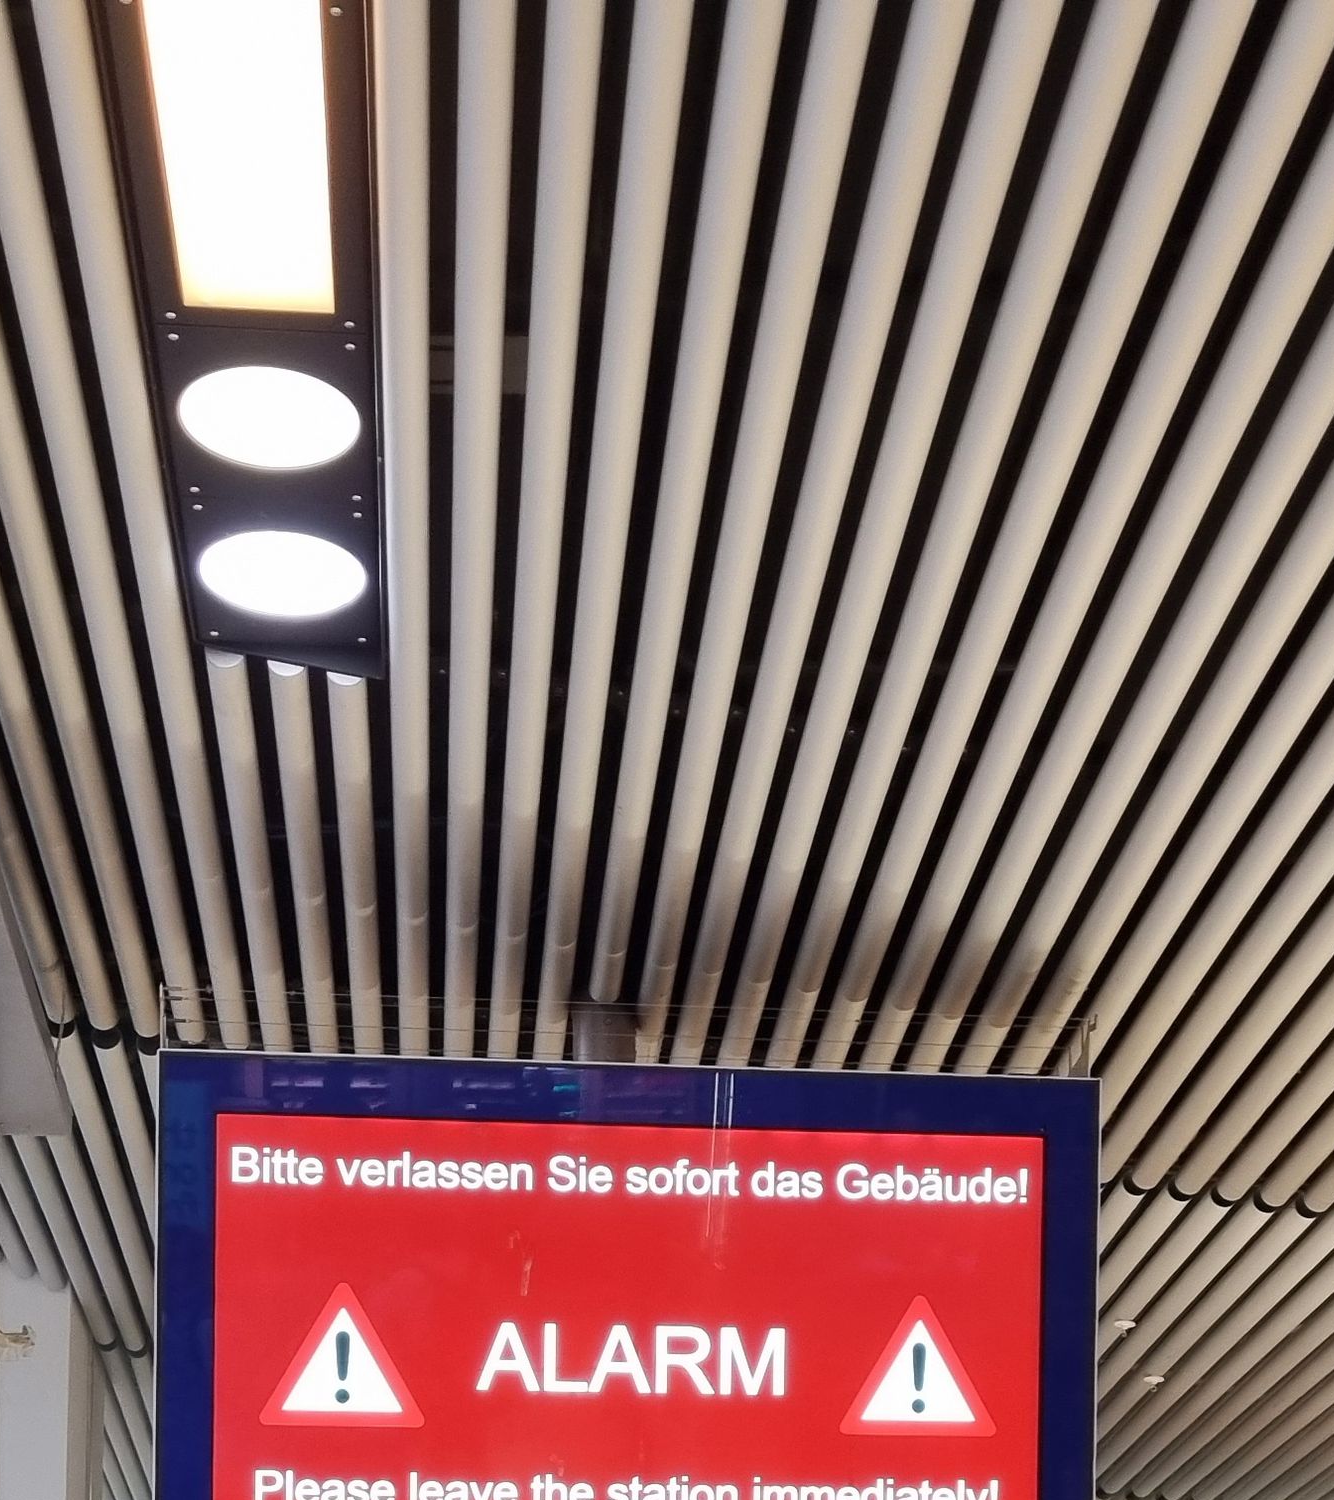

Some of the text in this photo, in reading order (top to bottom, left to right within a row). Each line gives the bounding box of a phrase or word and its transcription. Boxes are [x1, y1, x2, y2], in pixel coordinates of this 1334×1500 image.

[230, 1145, 1029, 1205] Bitte verlassen Sie sofort das Gebäude!
[475, 1321, 787, 1398] ALARM
